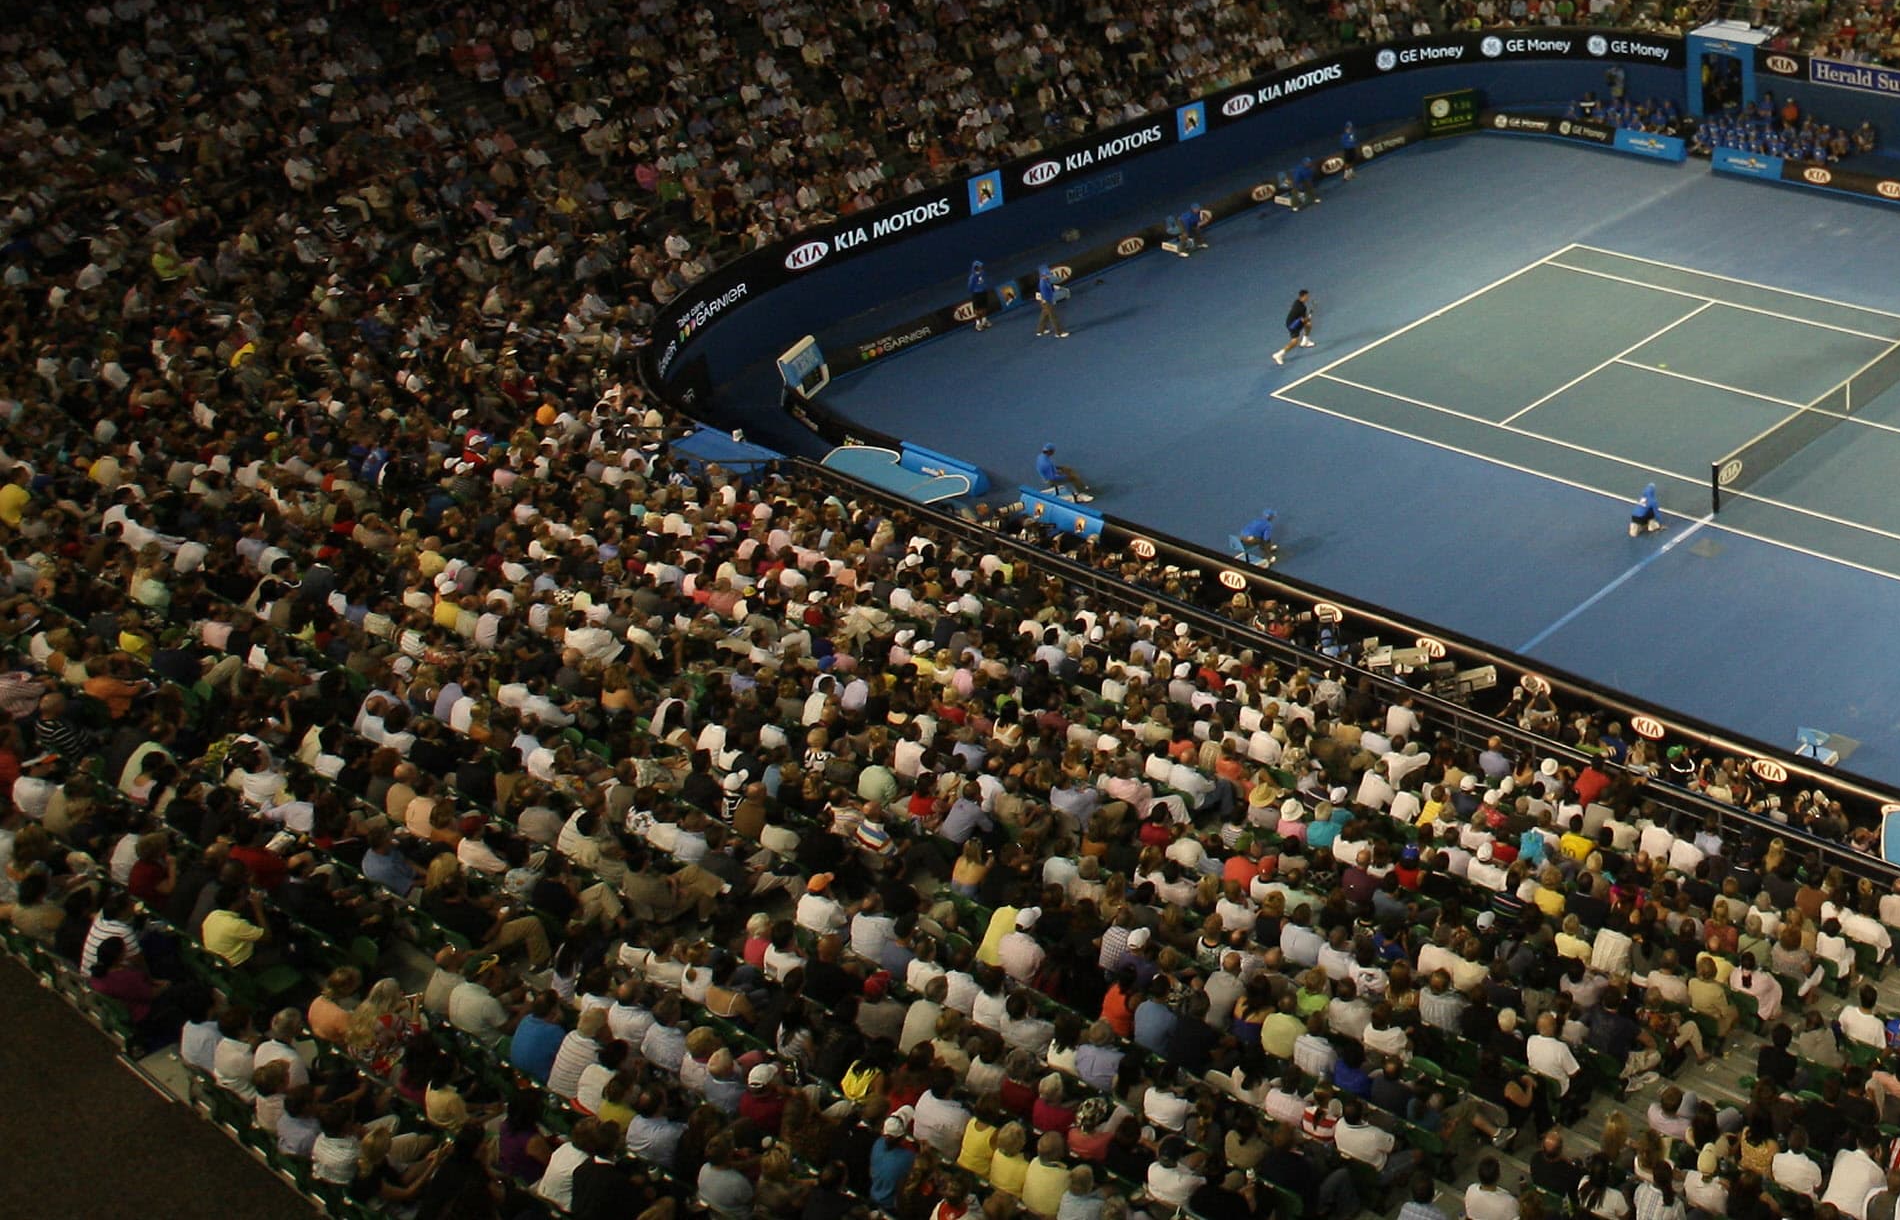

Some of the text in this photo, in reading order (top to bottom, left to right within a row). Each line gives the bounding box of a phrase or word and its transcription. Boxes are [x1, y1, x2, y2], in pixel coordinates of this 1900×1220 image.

[1399, 45, 1464, 64] GE Money
[1506, 38, 1571, 53] GE Money
[1610, 40, 1669, 61] GE Money
[1771, 57, 1793, 72] KIA
[1257, 63, 1342, 104] KIA MOTORS
[1816, 62, 1873, 88] Herald
[1226, 96, 1251, 113] KIA
[1066, 125, 1162, 171] KIA MOTORS
[1028, 164, 1056, 184] KIA
[1808, 169, 1828, 182] KIA
[1254, 184, 1275, 200] KIA
[834, 197, 950, 251] KIA MOTORS
[1120, 238, 1141, 254] KIA
[791, 245, 824, 267] KIA
[696, 283, 748, 326] GARNIER
[676, 313, 691, 329] Take
[883, 326, 932, 352] GARNIER
[1720, 462, 1740, 482] KIA
[1224, 573, 1242, 588] KIA
[1636, 718, 1659, 737] KIA
[1756, 763, 1782, 781] KIA
